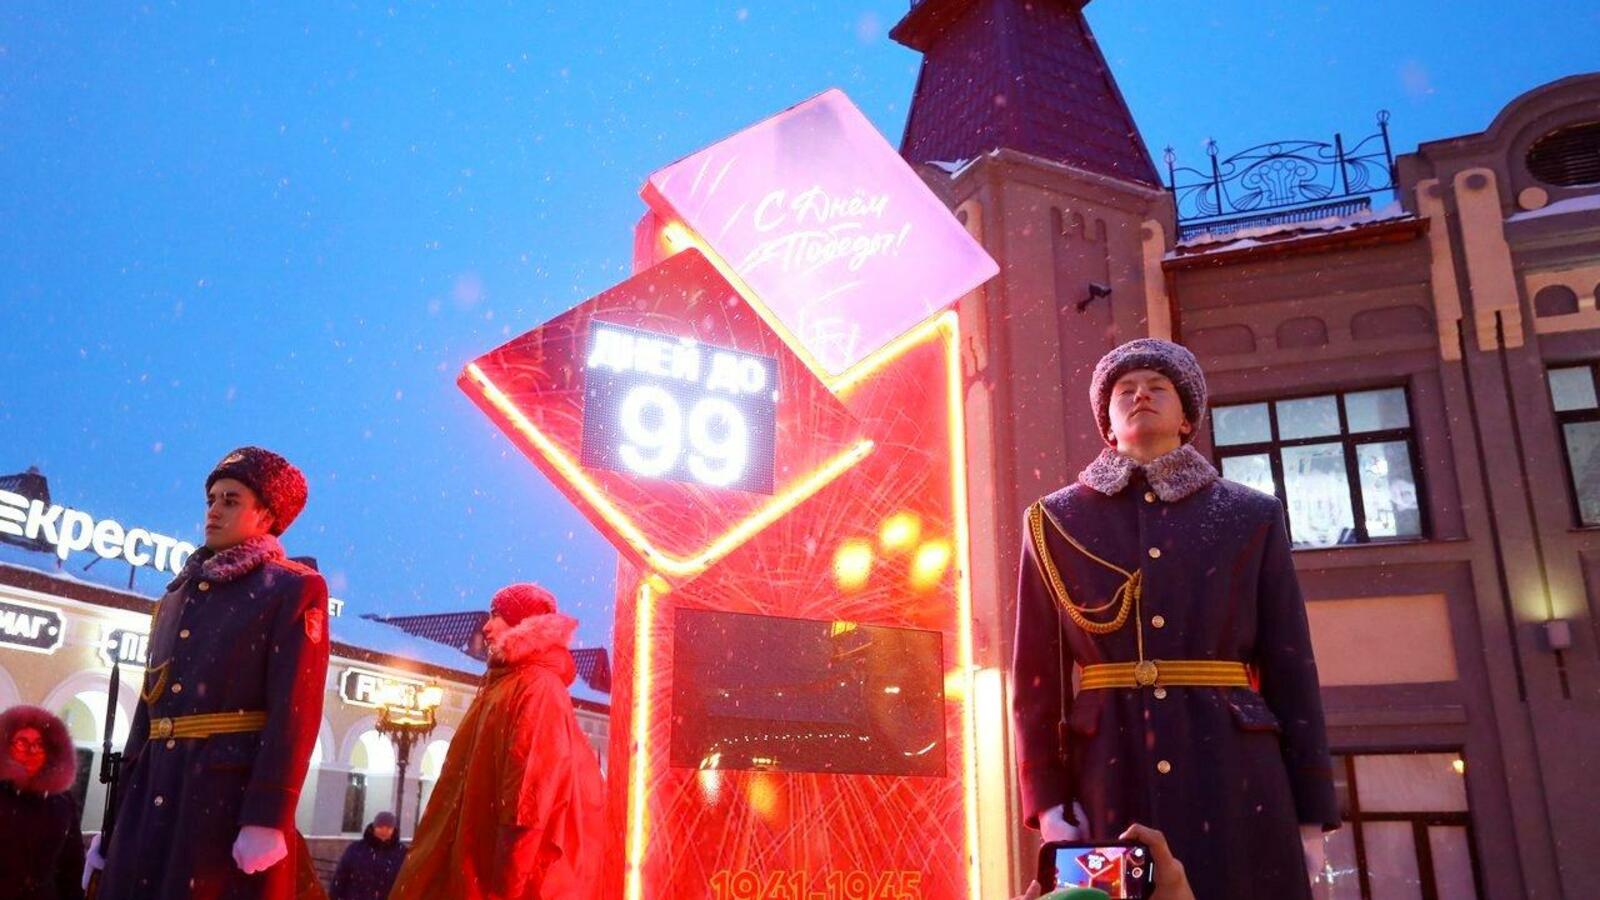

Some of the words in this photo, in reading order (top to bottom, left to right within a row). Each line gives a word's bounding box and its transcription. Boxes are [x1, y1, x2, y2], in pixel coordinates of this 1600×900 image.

[754, 189, 786, 232] С
[792, 185, 889, 223] Днём
[587, 327, 702, 382] ДНЕЙ
[707, 351, 767, 395] ДО
[619, 384, 749, 488] 99
